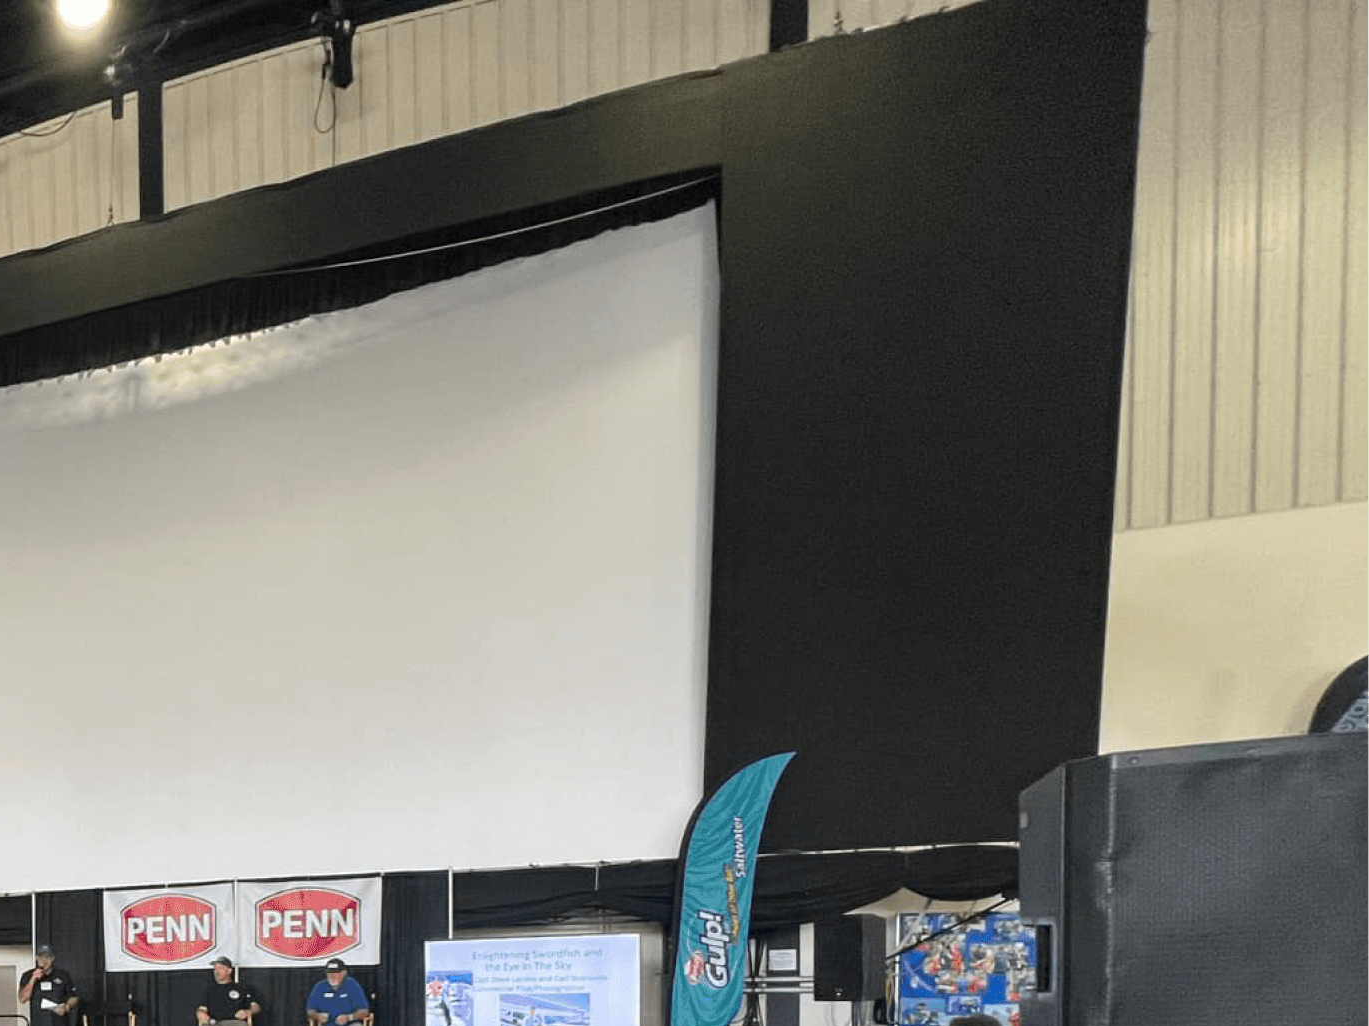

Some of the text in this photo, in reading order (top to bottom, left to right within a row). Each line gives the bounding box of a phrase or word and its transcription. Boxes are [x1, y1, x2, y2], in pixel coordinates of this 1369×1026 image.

[127, 912, 211, 945] PENN
[261, 907, 356, 939] PENN
[696, 908, 730, 988] Gulp!
